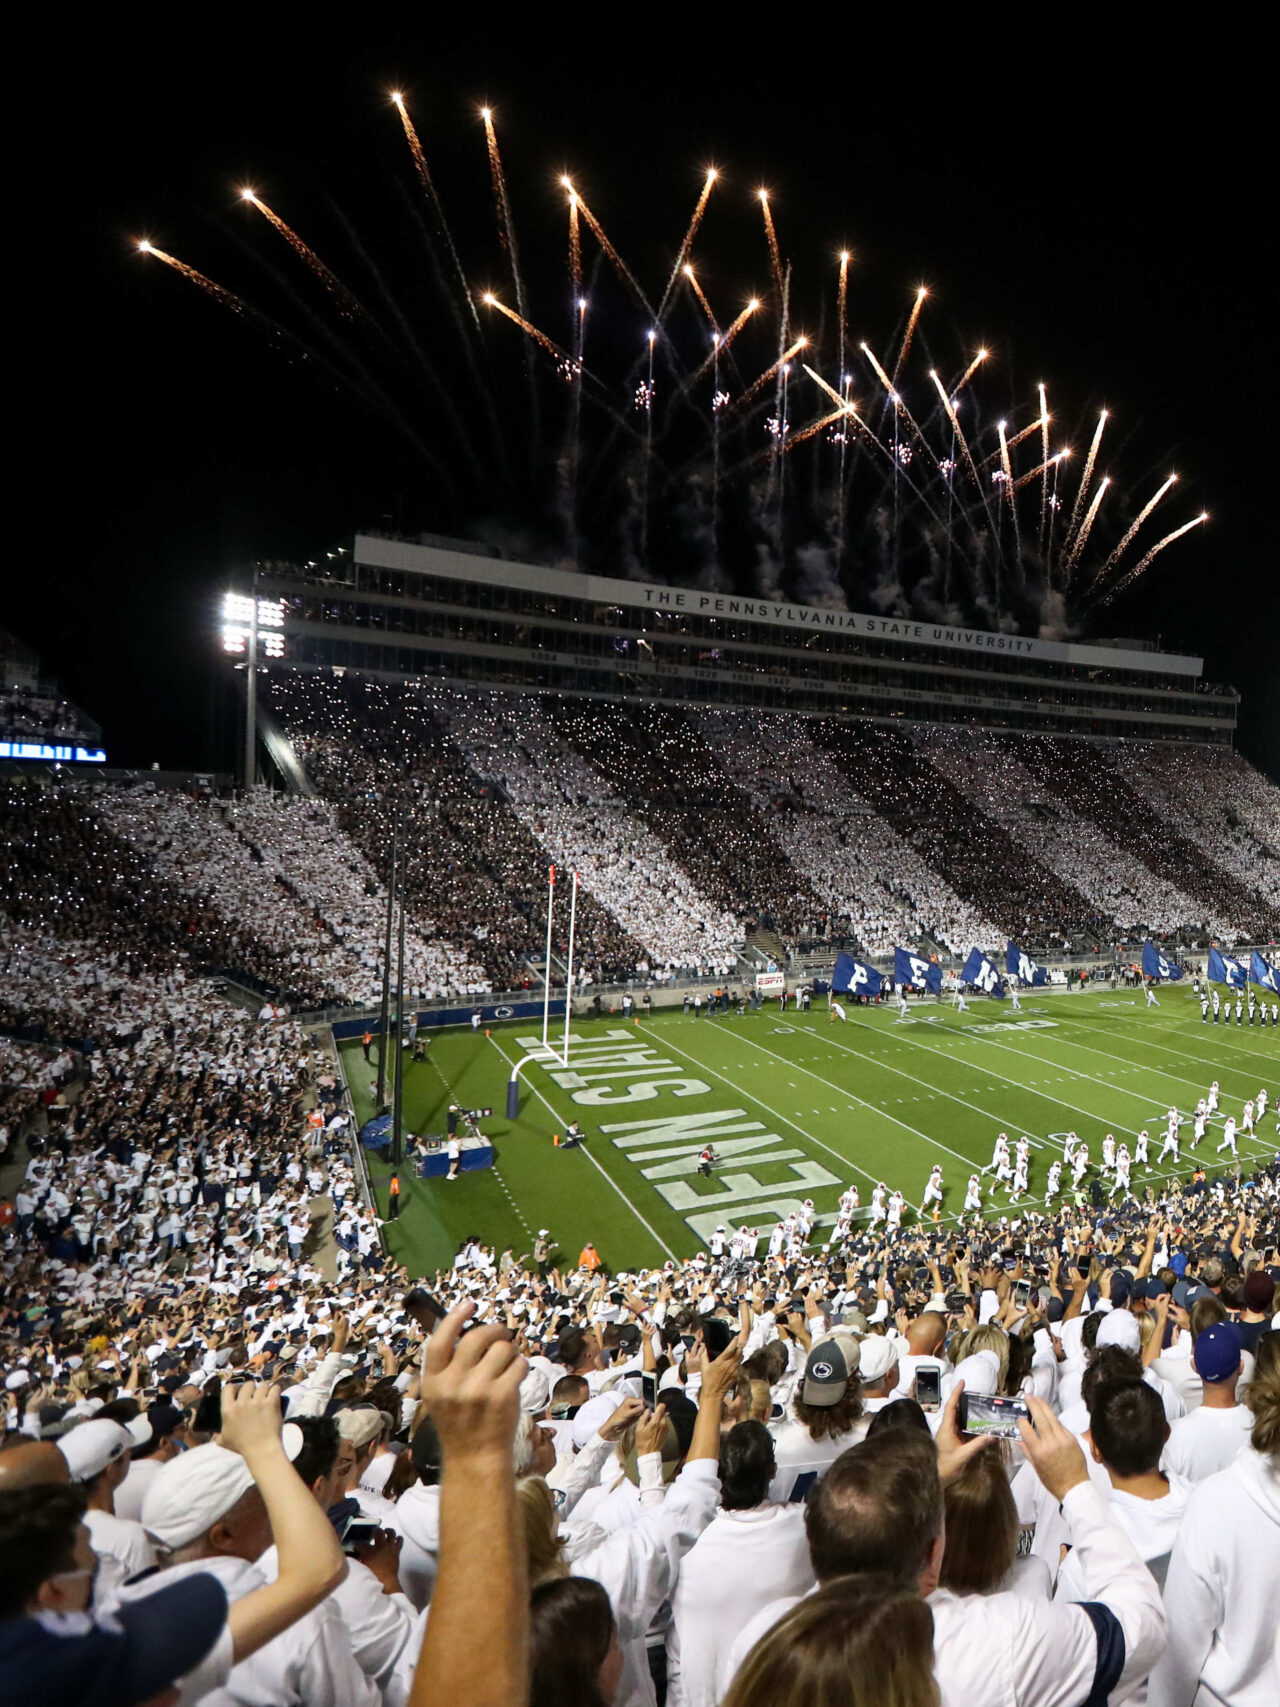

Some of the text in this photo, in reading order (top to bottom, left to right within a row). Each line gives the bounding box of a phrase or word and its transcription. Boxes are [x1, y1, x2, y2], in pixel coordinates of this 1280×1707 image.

[644, 590, 1034, 653] THE PENNSYLVANIA STATE UNIVERSITY
[574, 656, 600, 666] 1909
[614, 661, 639, 670] 1911
[758, 976, 783, 986] ESPN
[847, 963, 868, 992] P
[909, 957, 930, 988] E
[974, 960, 998, 992] N
[1018, 953, 1039, 984] N
[514, 1029, 878, 1250] PENN STATE
[733, 1238, 744, 1247] 20
